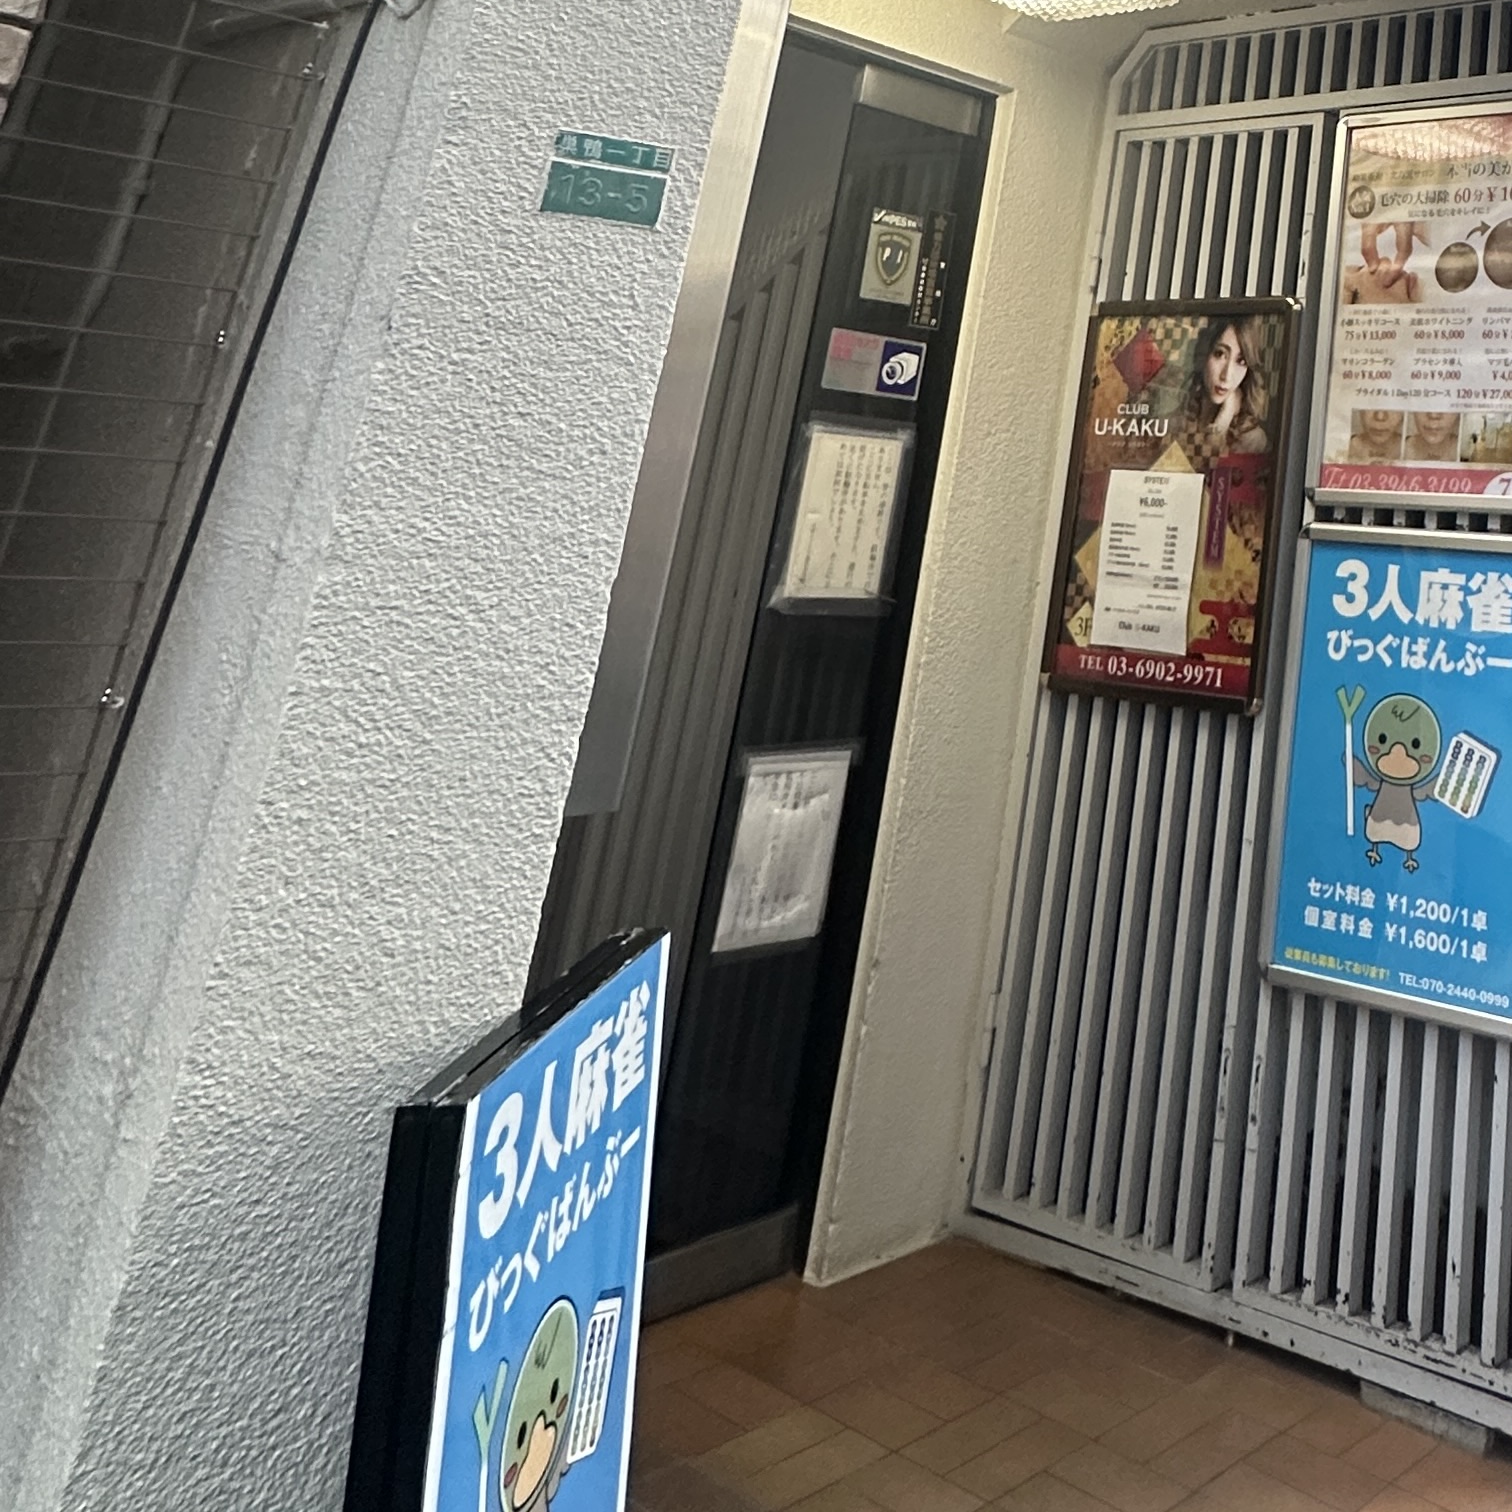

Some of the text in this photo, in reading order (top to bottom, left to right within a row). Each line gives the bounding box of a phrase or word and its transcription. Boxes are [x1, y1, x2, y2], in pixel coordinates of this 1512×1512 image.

[560, 135, 672, 169] 巣鴨一丁目
[561, 174, 648, 212] 13-5
[1380, 189, 1450, 207] 毛穴の大掃除
[1117, 403, 1150, 415] CLUB
[1079, 654, 1223, 688] TEL 03-6902-9971
[1307, 877, 1488, 931] セット料金 ¥1,200/1卓
[1304, 905, 1488, 963] 個室料金 ¥1,600/1卓
[478, 980, 652, 1240] 3人麻雀
[468, 1125, 642, 1353] びっぐばんぶー
